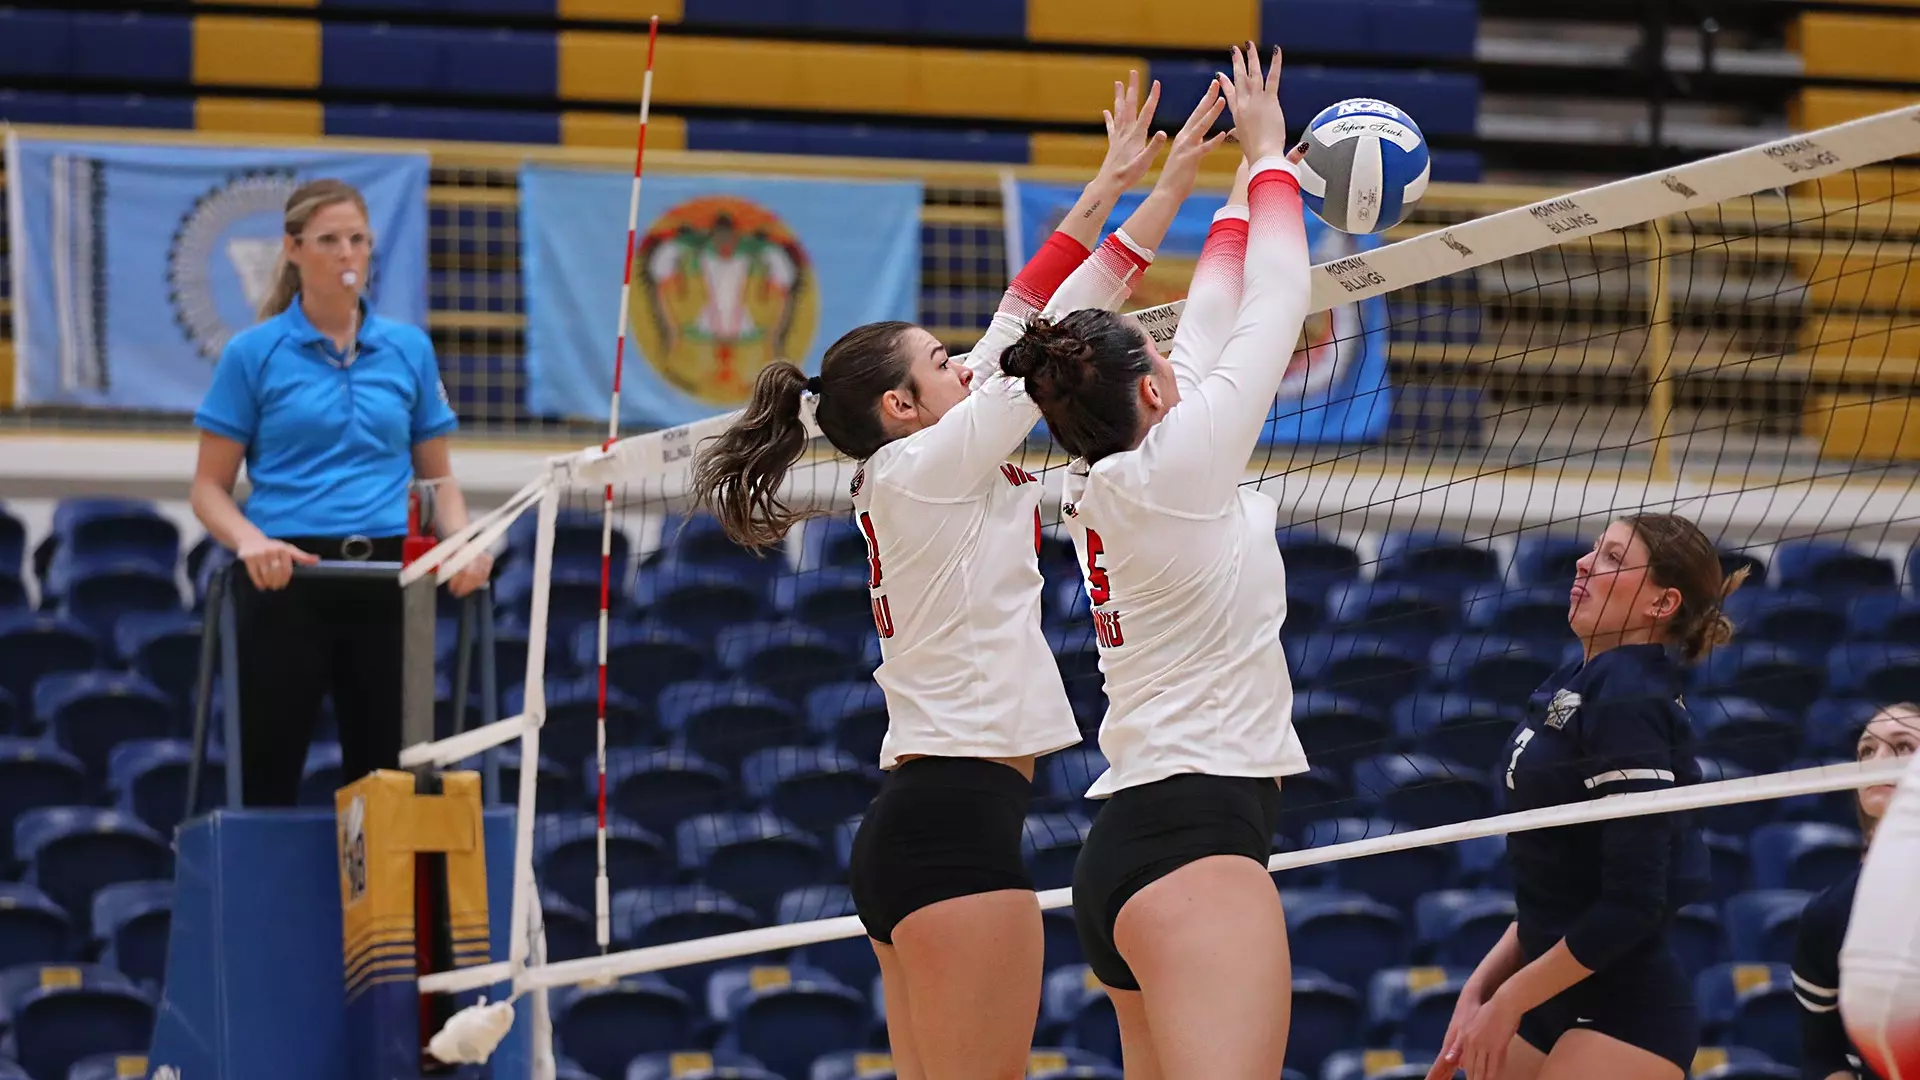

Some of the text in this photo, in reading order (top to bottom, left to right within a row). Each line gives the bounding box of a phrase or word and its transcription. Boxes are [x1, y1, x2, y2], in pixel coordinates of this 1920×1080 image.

[1336, 101, 1399, 119] NCAA
[1332, 121, 1403, 137] Super Touch
[1528, 198, 1581, 219] MONTANA
[1324, 256, 1367, 276] MONTANA
[1339, 271, 1387, 293] BILLINGS
[1136, 305, 1178, 326] MONTANA
[1149, 323, 1179, 343] BILLIN
[1086, 527, 1111, 607] 5
[1505, 727, 1536, 790] 7
